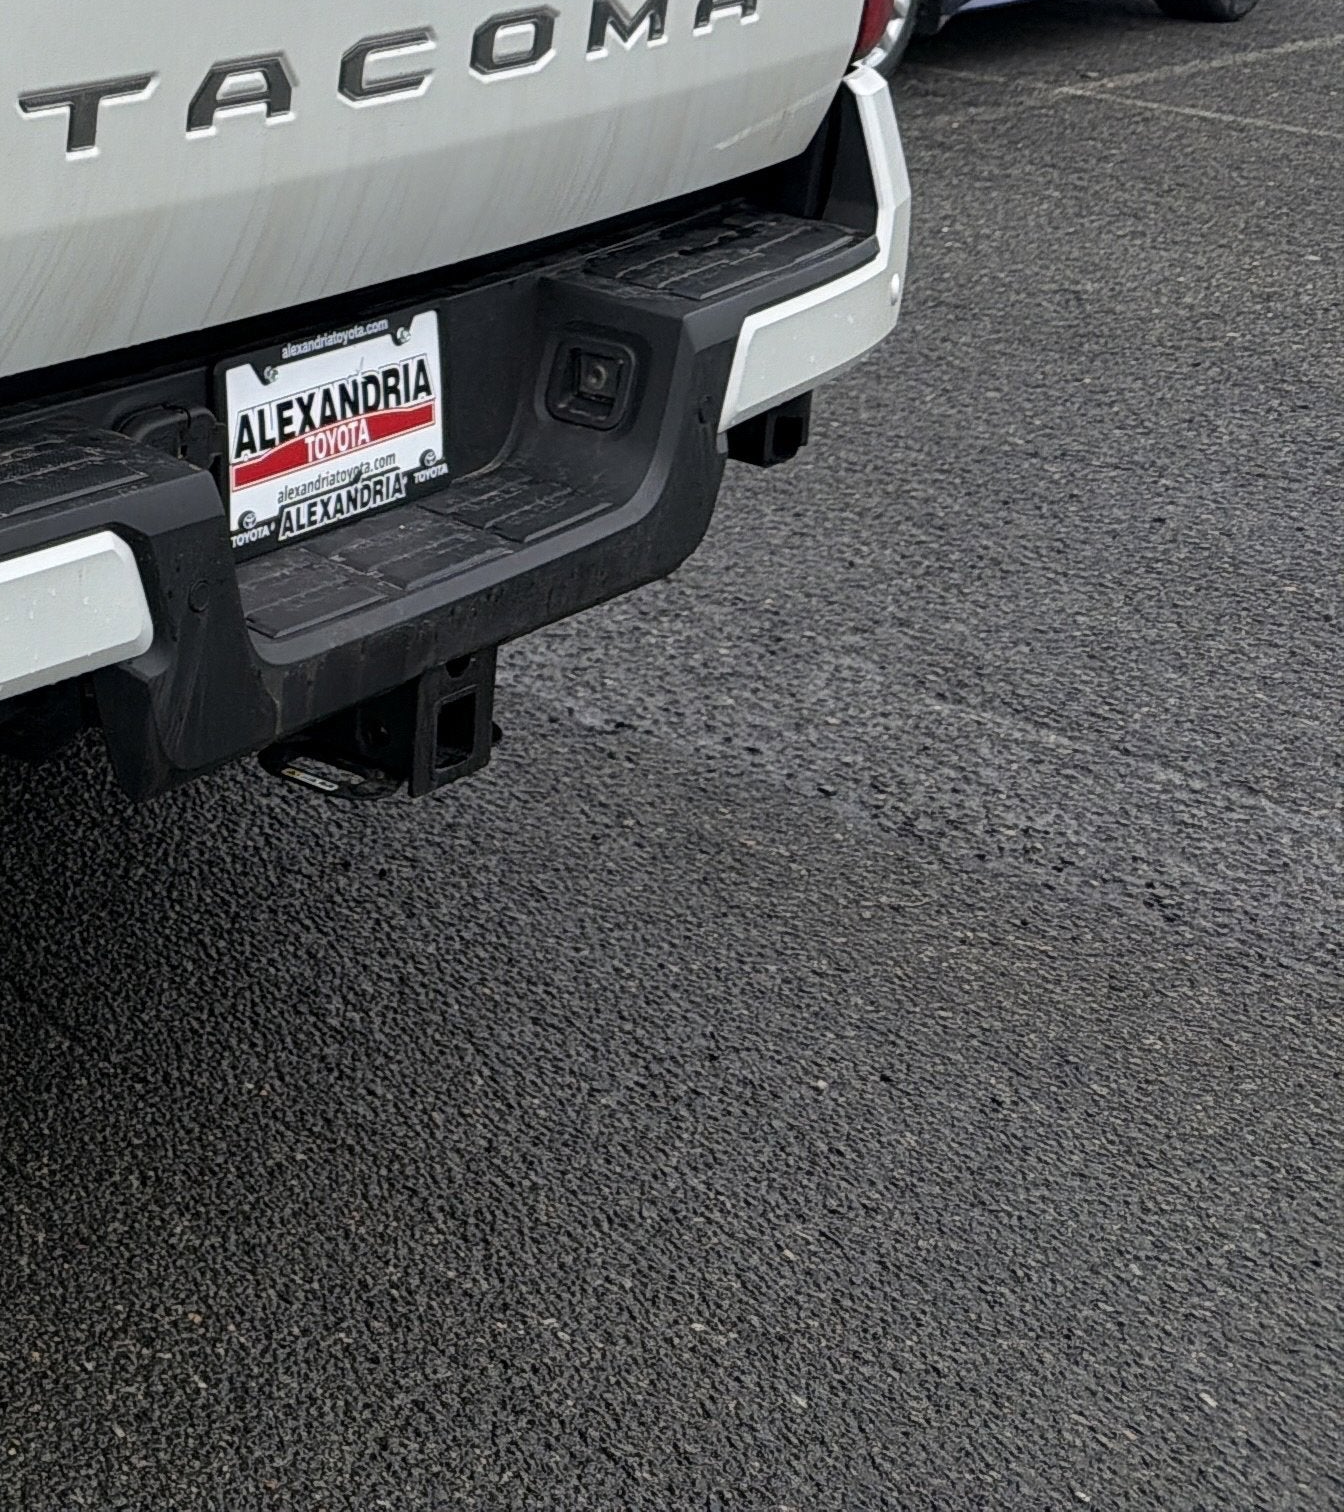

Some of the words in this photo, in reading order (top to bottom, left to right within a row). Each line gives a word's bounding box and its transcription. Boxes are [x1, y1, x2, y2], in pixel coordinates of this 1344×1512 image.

[280, 318, 389, 360] alexandriatoyota.com
[233, 357, 433, 461] ALEXANDRIA
[304, 419, 371, 463] TOYOTA
[277, 452, 396, 505] alexandriatoyota.com
[413, 462, 449, 485] TOYOTA
[278, 469, 406, 541] ALEXANDRIA
[230, 524, 270, 549] TOYOTA
